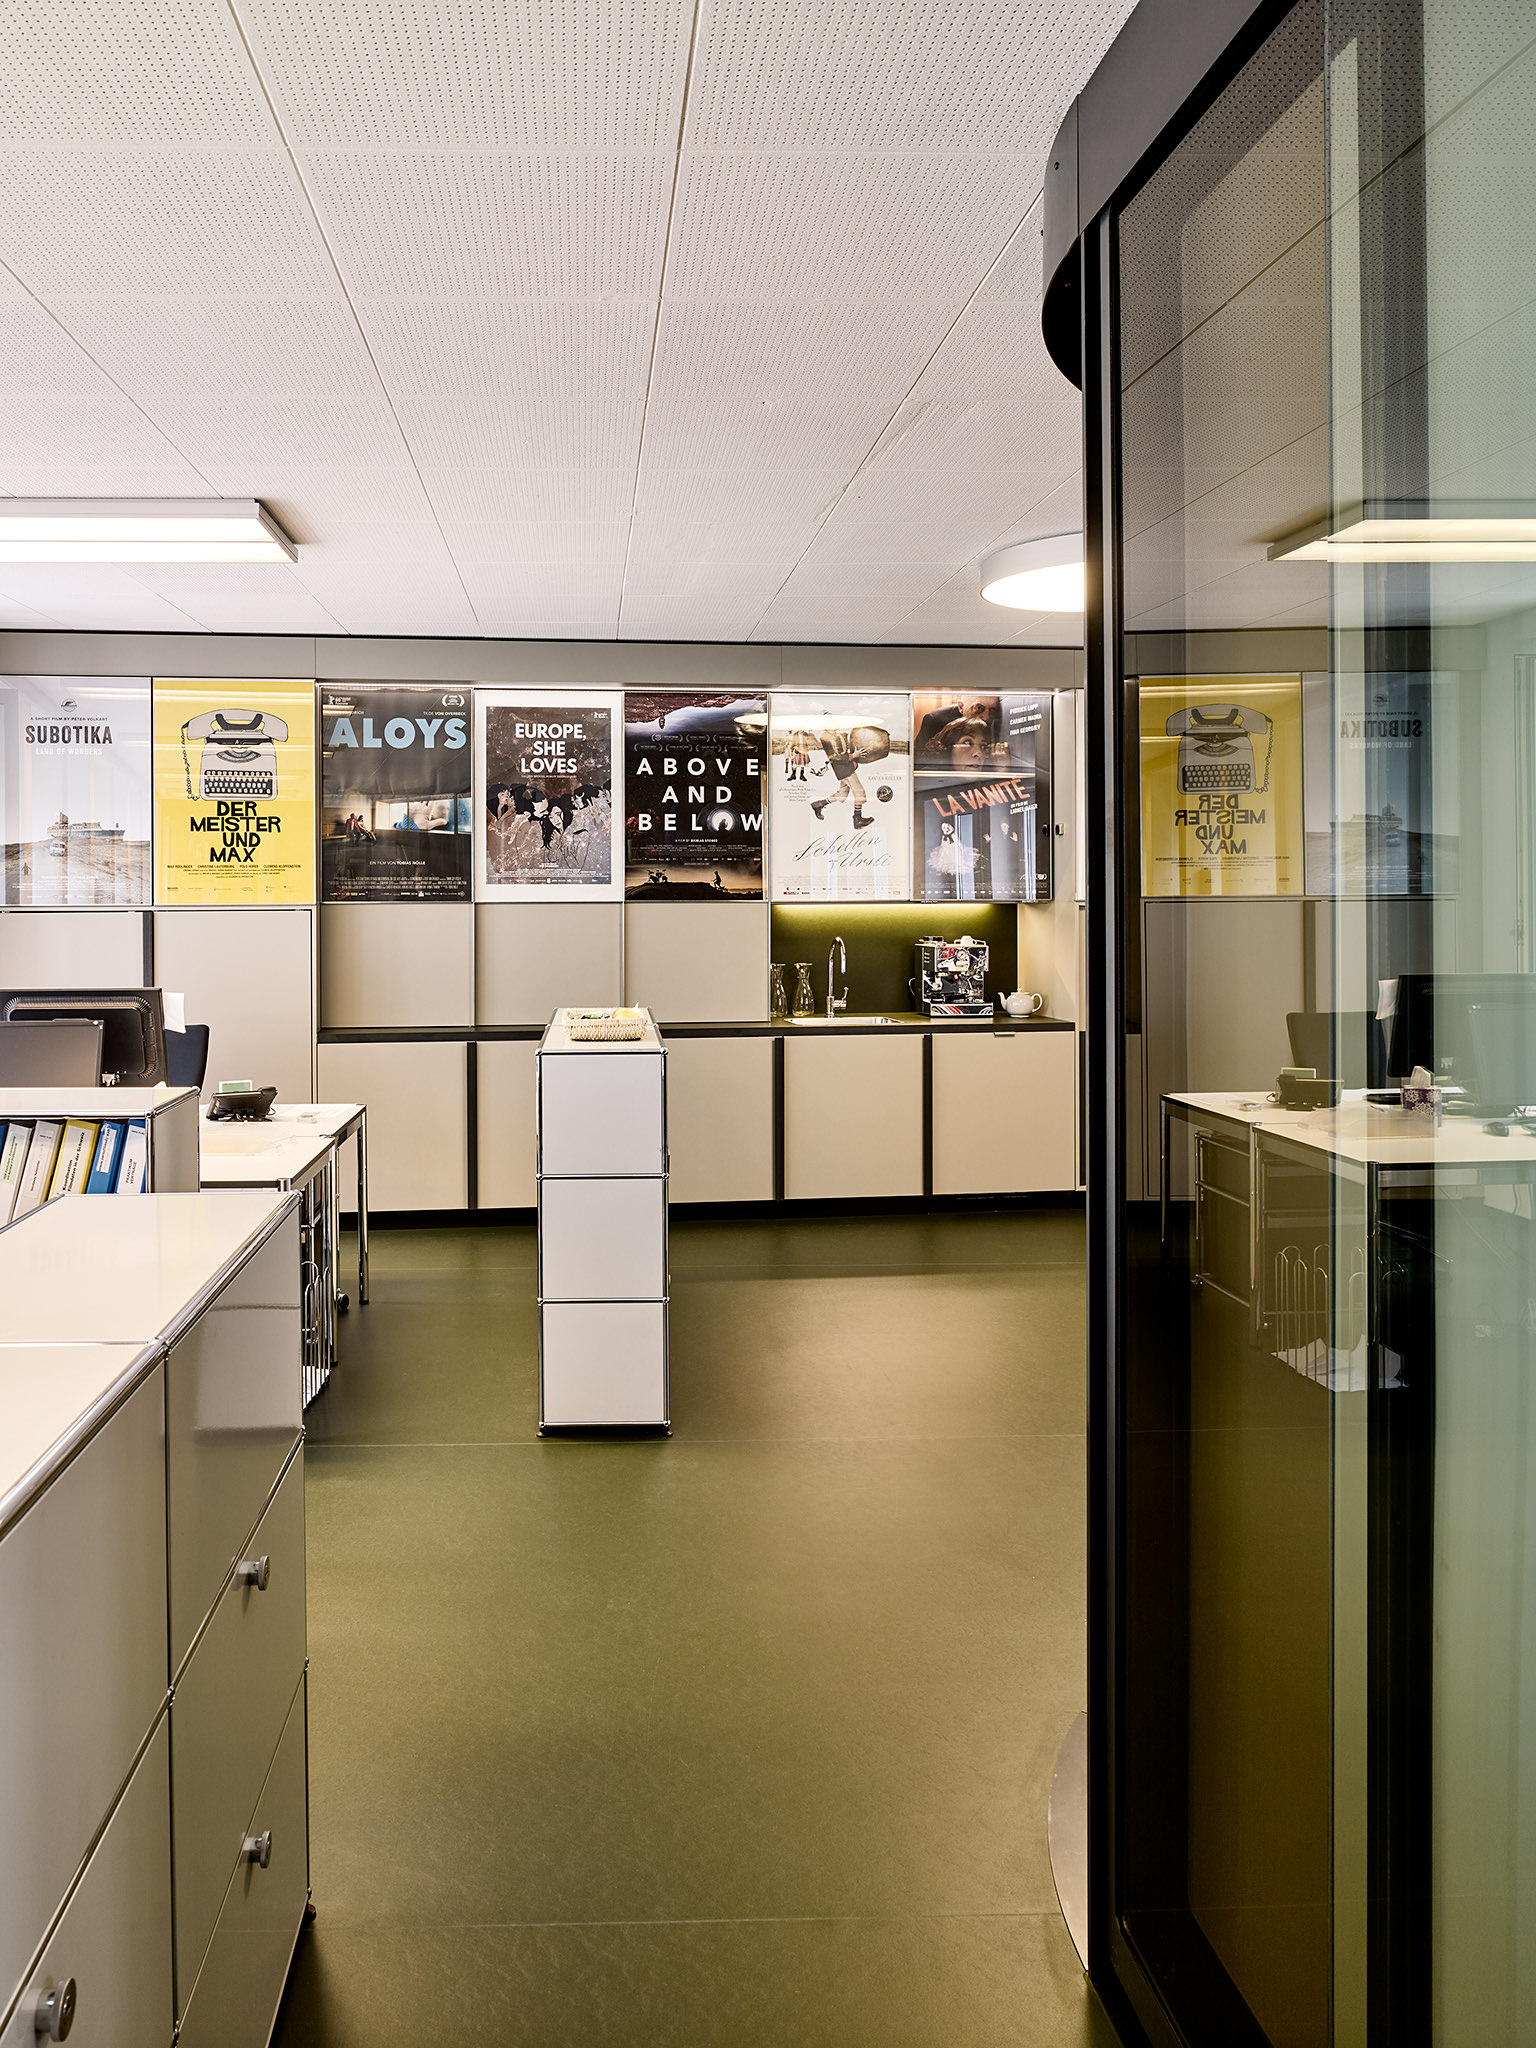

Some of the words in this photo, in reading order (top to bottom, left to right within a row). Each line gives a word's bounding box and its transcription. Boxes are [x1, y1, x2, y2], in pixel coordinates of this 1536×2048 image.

[25, 725, 113, 744] SUBOTIKA
[328, 717, 467, 750] ALOYS
[515, 723, 587, 741] EUROPE,
[36, 748, 54, 756] LAND
[56, 748, 66, 756] OF
[68, 748, 103, 756] WONDERS
[533, 740, 566, 756] SHE
[521, 757, 578, 774] LOVES
[636, 757, 759, 776] ABOVE
[661, 785, 732, 804] AND
[932, 794, 966, 817] LA
[960, 776, 1031, 811] VANITÉ
[217, 800, 258, 817] DER
[190, 816, 282, 833] MEISTER
[637, 812, 764, 831] BELOW
[222, 832, 262, 848] UND
[209, 847, 255, 863] MAX
[77, 1132, 85, 1152] Schweiz
[62, 1159, 73, 1191] Koordination
